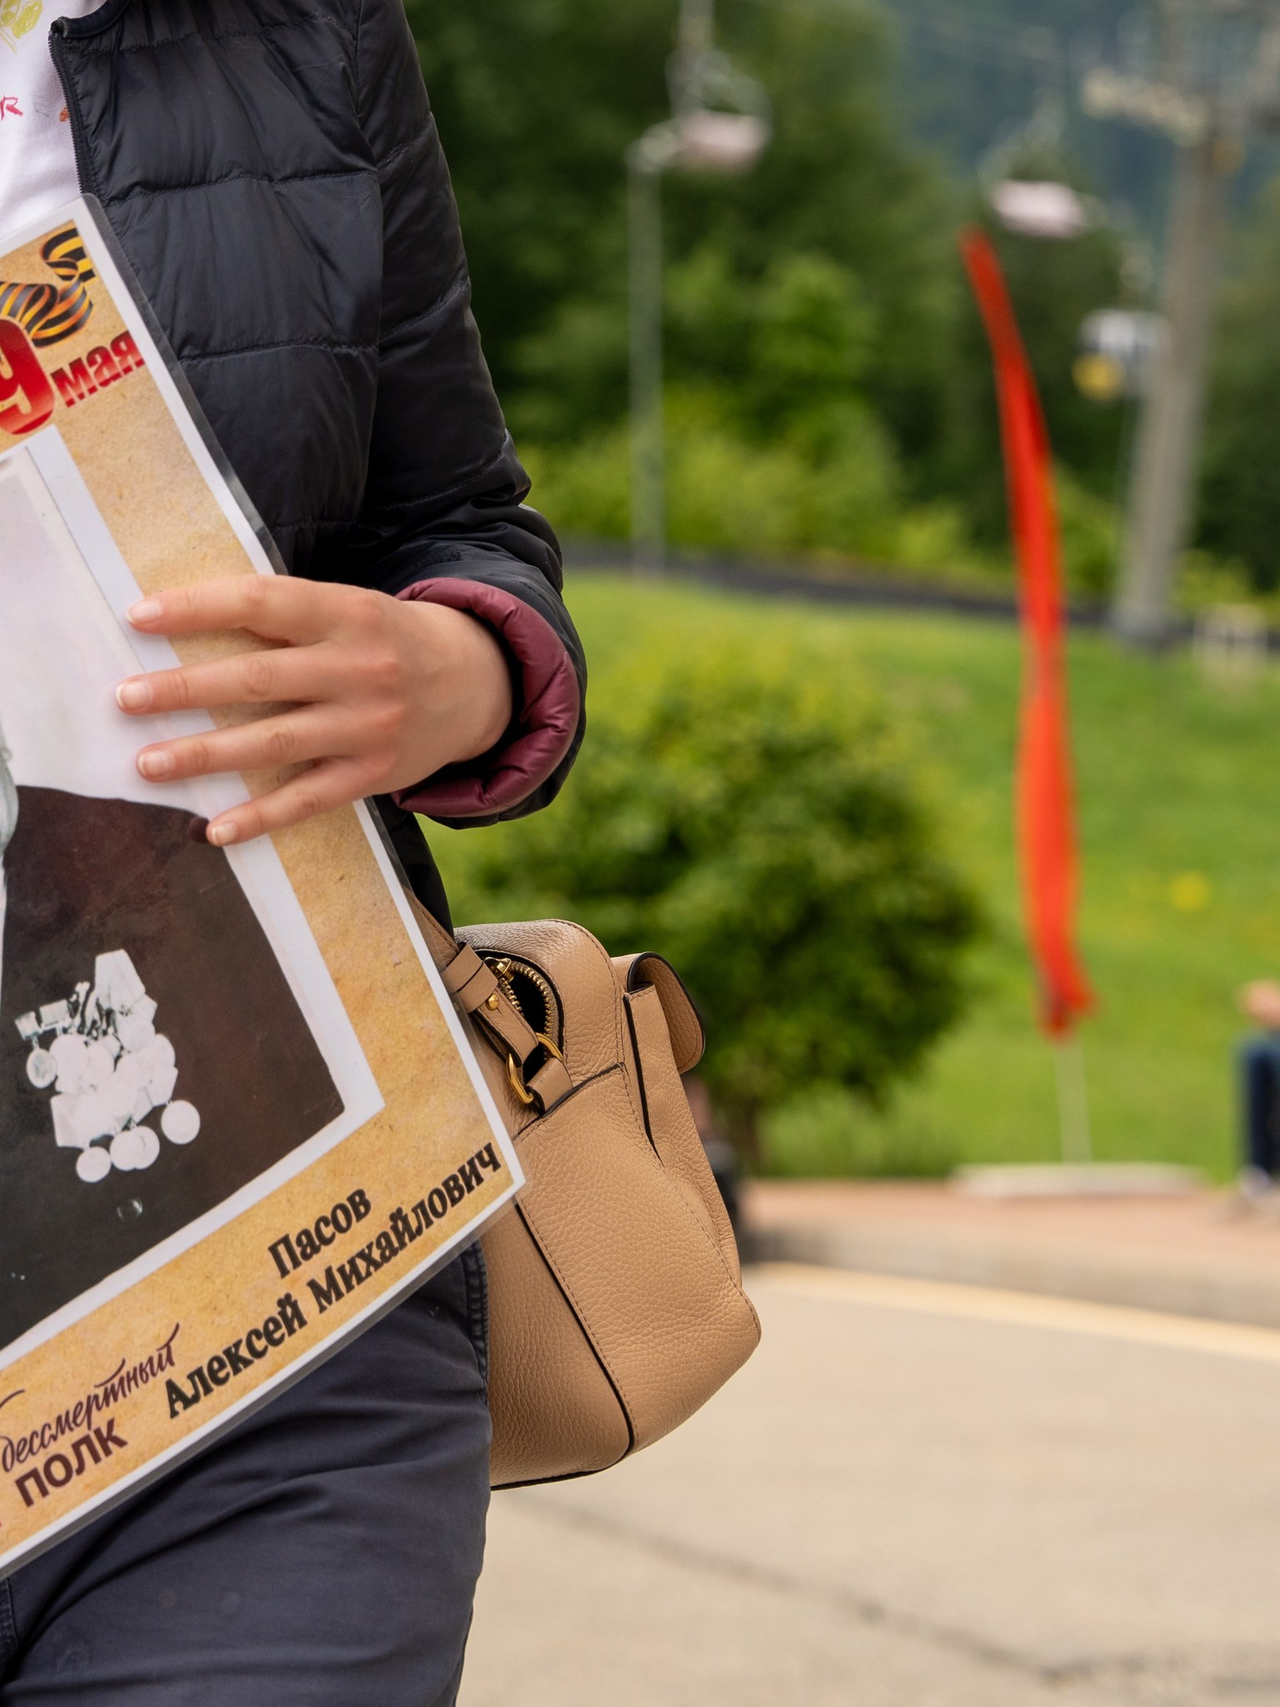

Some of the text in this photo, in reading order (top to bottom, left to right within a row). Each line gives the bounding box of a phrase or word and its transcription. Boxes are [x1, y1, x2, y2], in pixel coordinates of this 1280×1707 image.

[50, 330, 145, 408] мая
[268, 1189, 371, 1278] Пасов
[165, 1142, 501, 1419] Алексей Михайлович
[15, 1417, 128, 1507] ПОЛК
